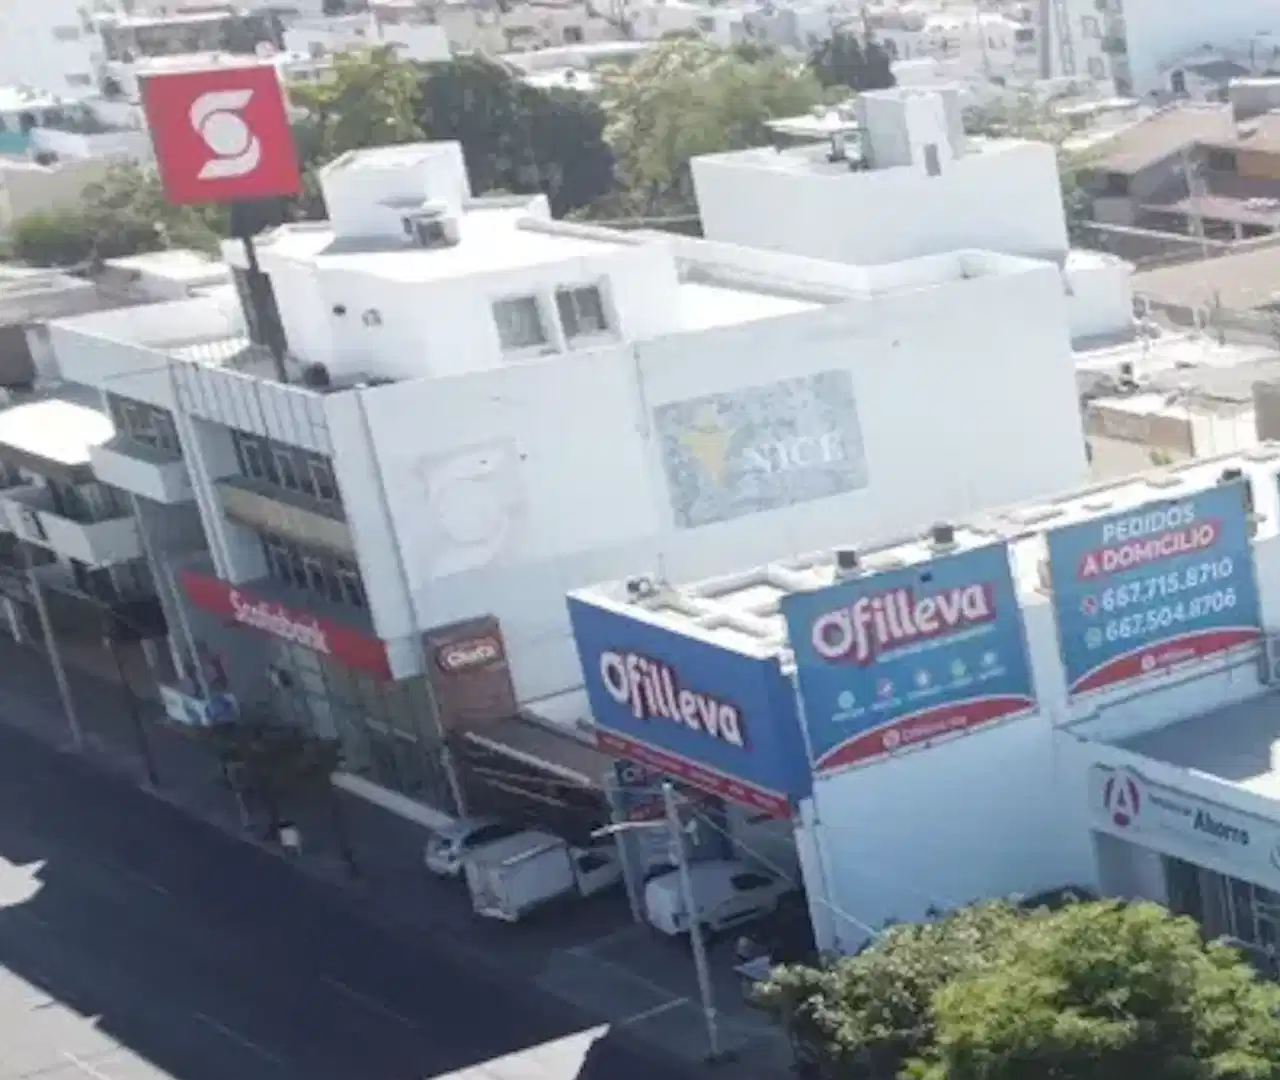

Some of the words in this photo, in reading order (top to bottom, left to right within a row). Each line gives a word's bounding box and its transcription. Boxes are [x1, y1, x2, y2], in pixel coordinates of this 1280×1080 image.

[1082, 554, 1099, 577] A
[1103, 523, 1215, 570] DOMICILIO
[1103, 501, 1195, 544] PEDIDOS
[1102, 555, 1234, 611] 667.715.8710
[811, 583, 991, 662] Ofilleva
[601, 651, 745, 747] Ofilleva
[1192, 807, 1250, 847] Ahorro
